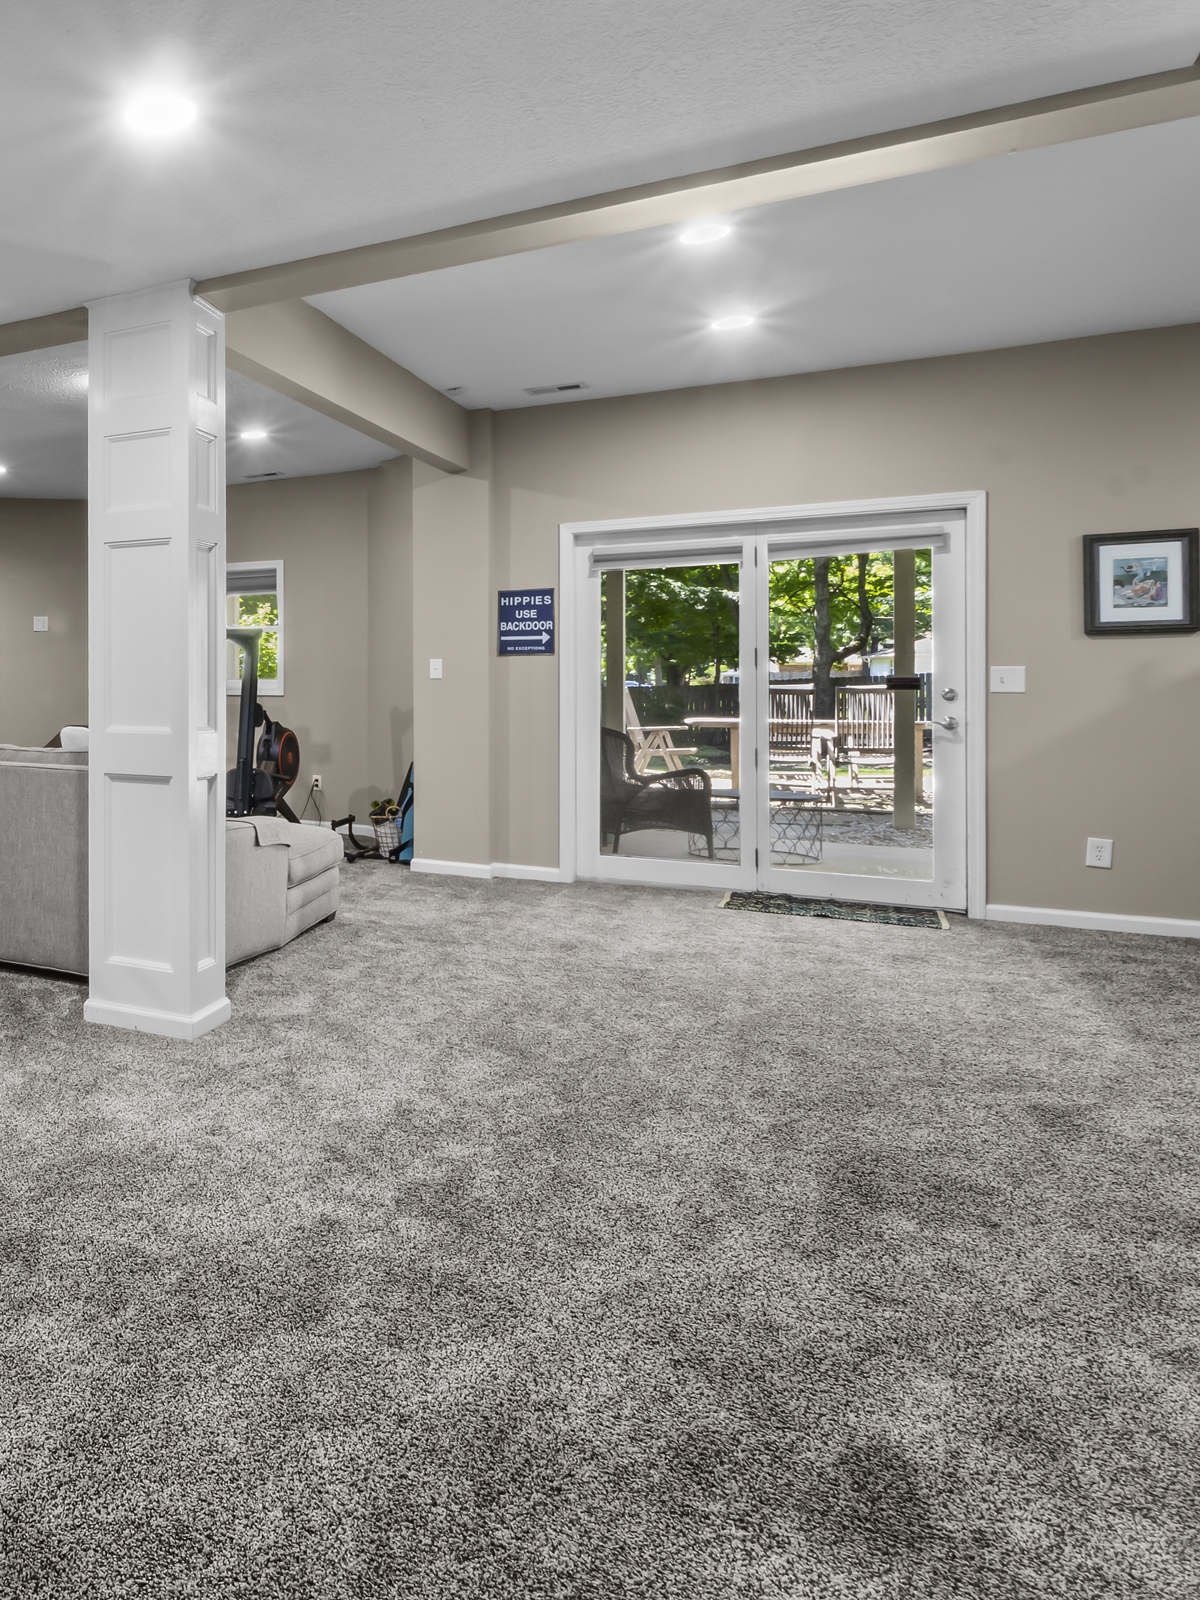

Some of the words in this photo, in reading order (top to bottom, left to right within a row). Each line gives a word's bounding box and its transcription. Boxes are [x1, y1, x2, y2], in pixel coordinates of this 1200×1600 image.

[501, 596, 552, 606] HIPPIES
[515, 609, 538, 618] USE
[500, 620, 553, 631] BACKDOOR
